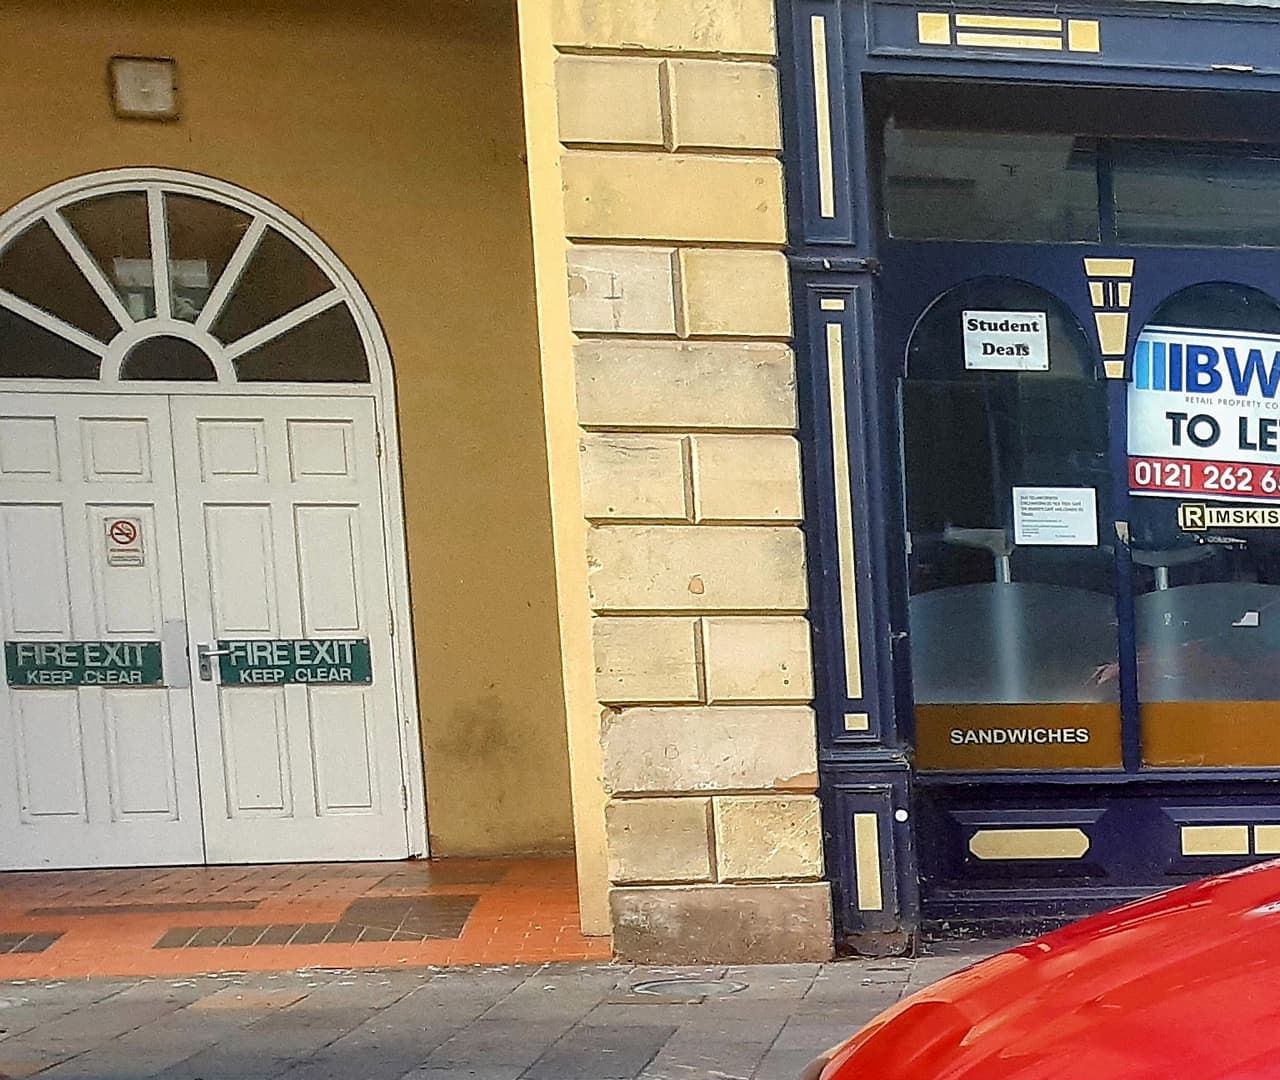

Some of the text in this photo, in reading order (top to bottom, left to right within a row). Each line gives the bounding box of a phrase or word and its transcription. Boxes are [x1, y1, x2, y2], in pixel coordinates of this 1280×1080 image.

[967, 318, 1040, 332] Student
[982, 342, 1030, 356] Deals
[1185, 396, 1214, 405] RETAIL
[1217, 399, 1261, 409] PROPERTY
[1166, 411, 1221, 448] TO
[1135, 461, 1191, 487] 0121
[1203, 466, 1253, 491] 262
[1183, 504, 1280, 528] RIMSKIS
[17, 642, 146, 668] FIRE EXIT
[229, 640, 356, 666] FIRE EXIT
[27, 670, 73, 684] KEEP
[239, 669, 285, 683] KEEP
[950, 728, 1090, 744] SANDWICHES
